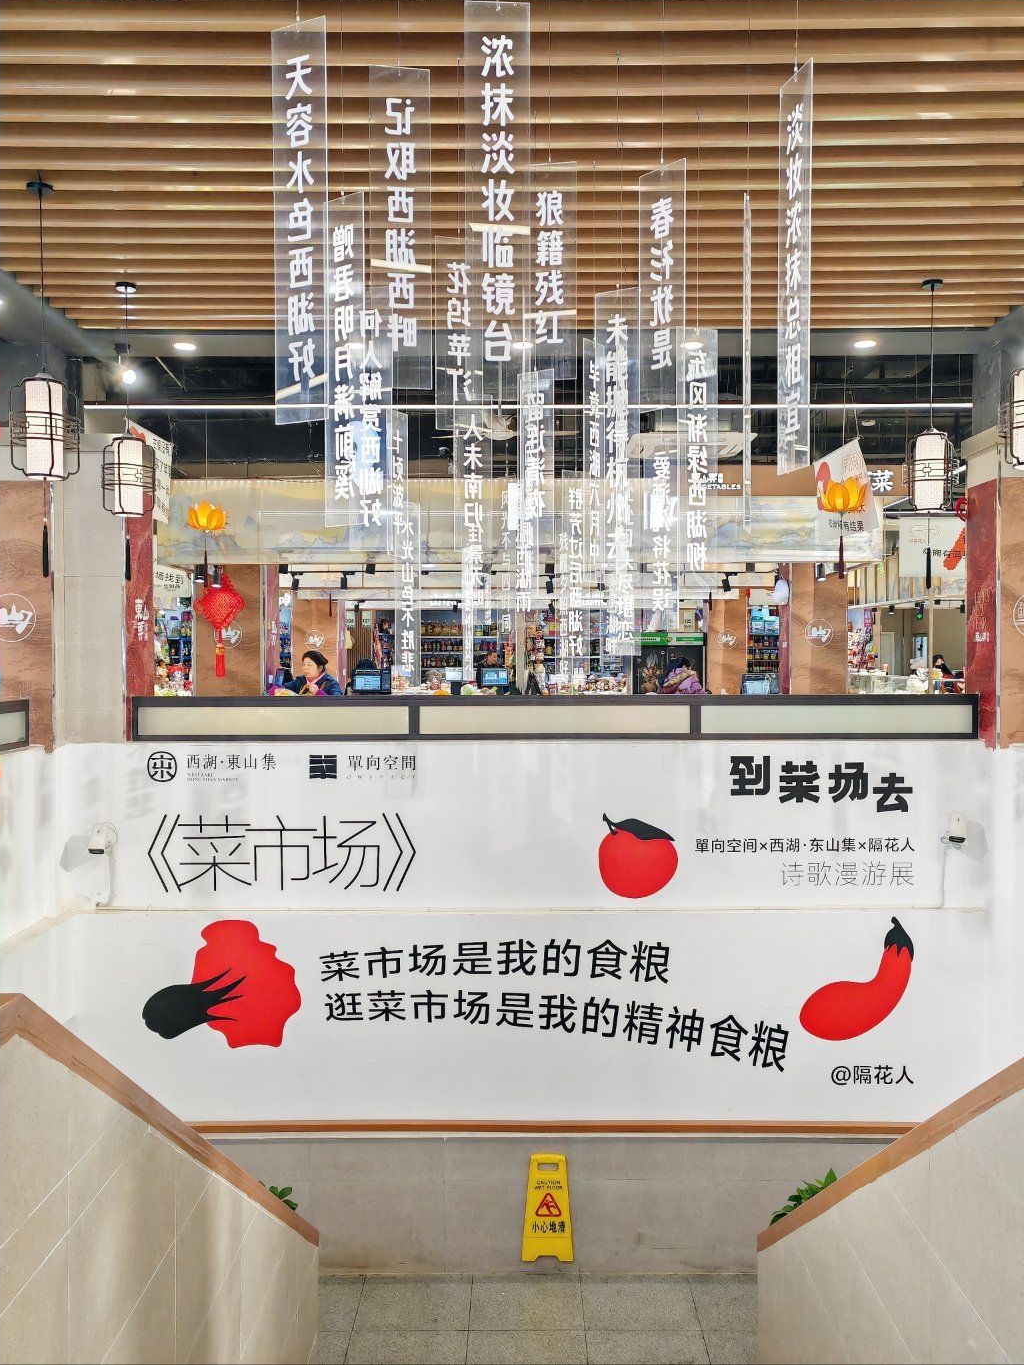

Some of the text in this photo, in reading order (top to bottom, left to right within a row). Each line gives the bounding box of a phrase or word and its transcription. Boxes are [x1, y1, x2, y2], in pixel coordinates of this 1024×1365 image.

[481, 35, 516, 363] 浓抹淡妆临镜台
[729, 755, 914, 813] 到菜场去
[780, 860, 915, 887] 诗歌漫游展
[319, 938, 671, 985] 菜市场是我的食粮
[324, 988, 791, 1073] 逛菜市场是我的精神食粮
[830, 1063, 915, 1086] @隔花人
[532, 1221, 566, 1233] 小心地滑
